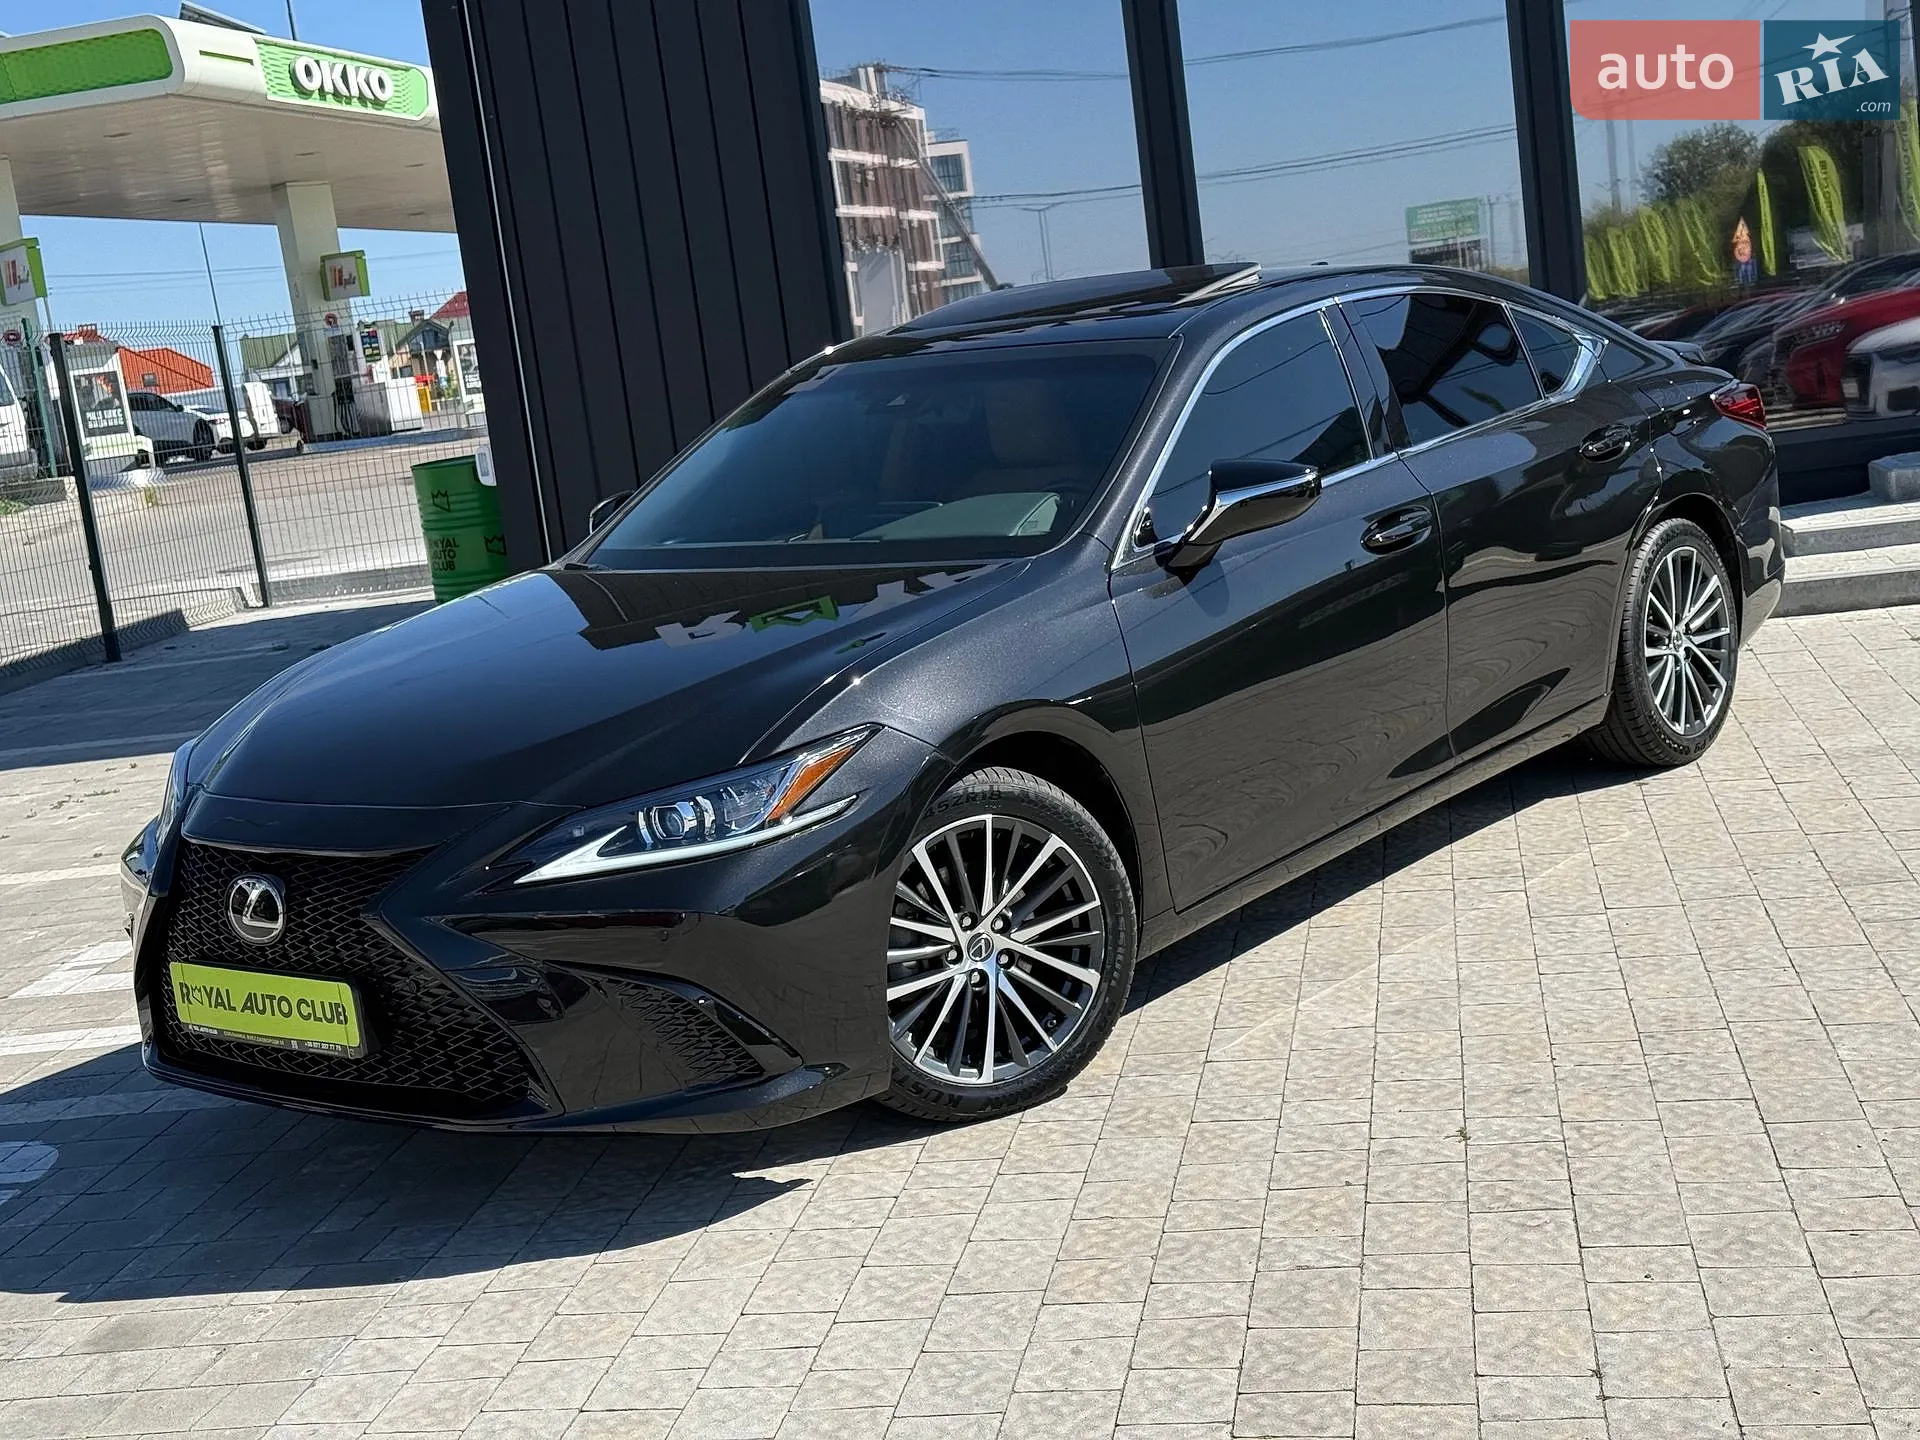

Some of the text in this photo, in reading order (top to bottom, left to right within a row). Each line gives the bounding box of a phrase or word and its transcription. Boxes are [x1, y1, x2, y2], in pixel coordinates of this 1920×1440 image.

[289, 54, 394, 102] OKKO
[432, 559, 456, 571] CLUB
[240, 991, 293, 1019] AUTO
[296, 998, 349, 1026] CLUB
